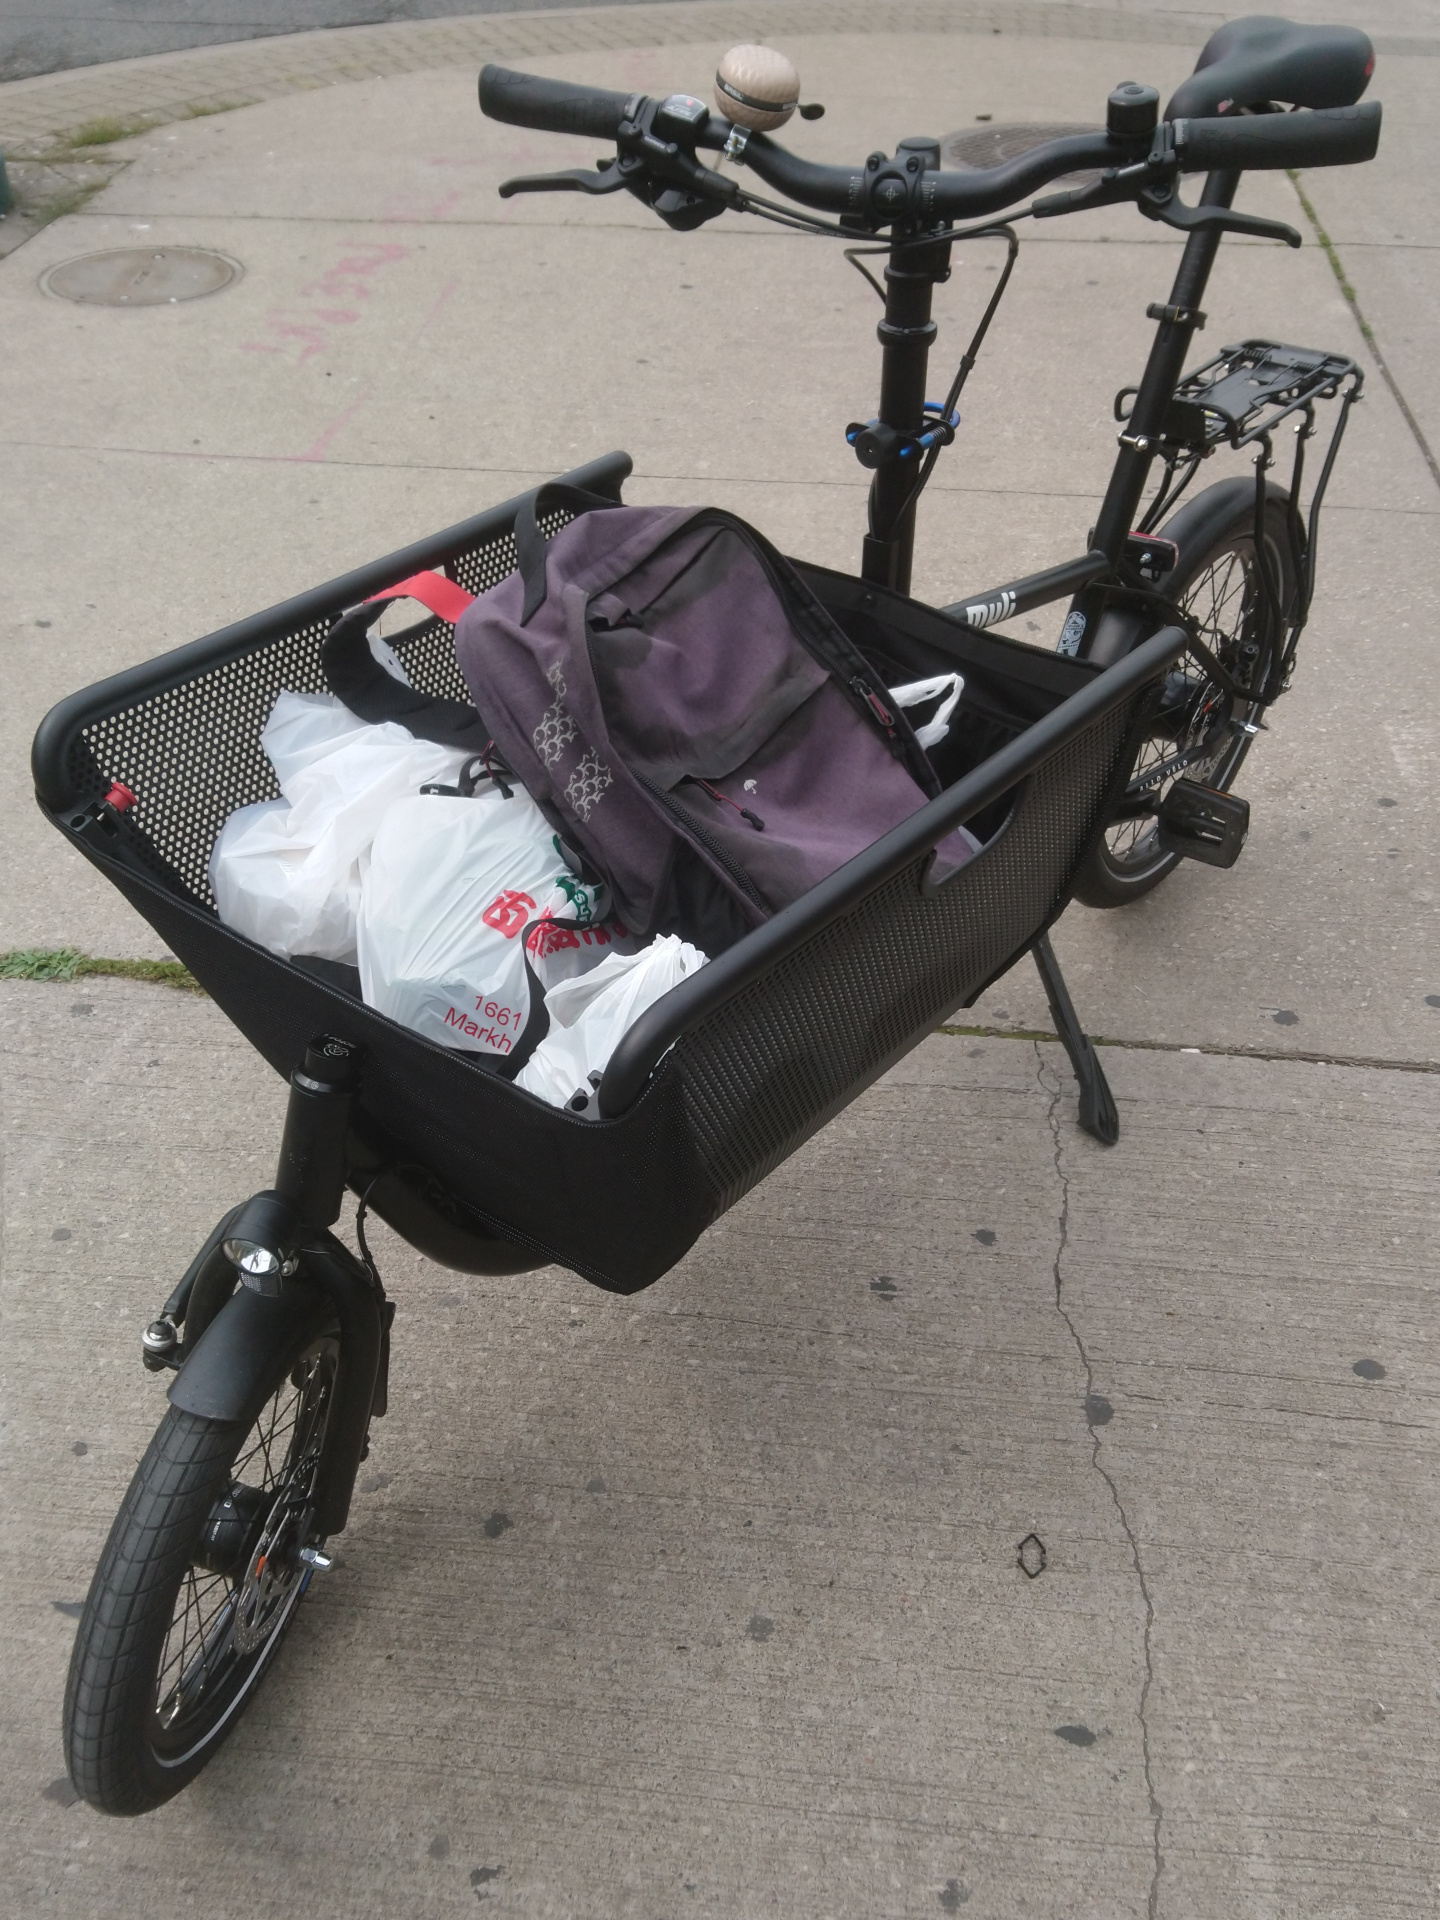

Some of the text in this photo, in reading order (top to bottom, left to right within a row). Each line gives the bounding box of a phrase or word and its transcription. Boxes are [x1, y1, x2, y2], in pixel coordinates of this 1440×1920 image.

[965, 591, 1016, 628] muli
[1139, 775, 1162, 793] ALLO
[443, 1006, 512, 1054] Markh
[475, 995, 522, 1031] 1661
